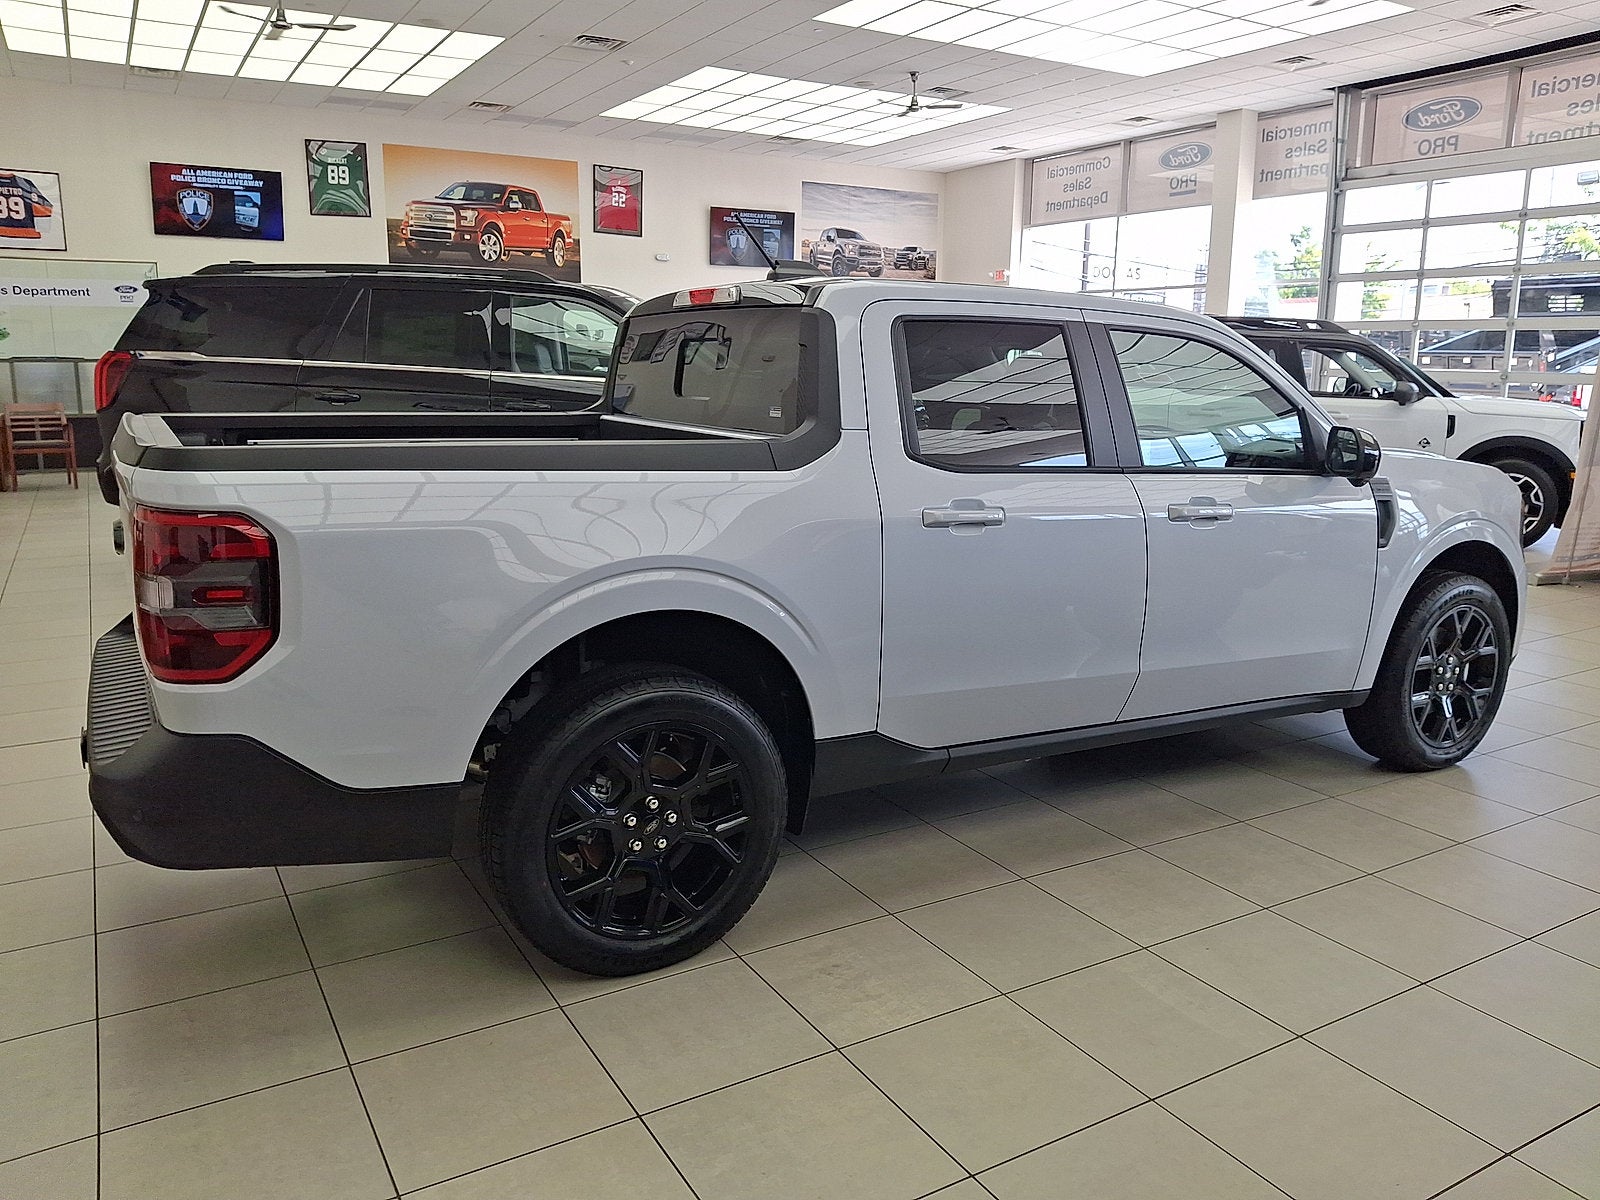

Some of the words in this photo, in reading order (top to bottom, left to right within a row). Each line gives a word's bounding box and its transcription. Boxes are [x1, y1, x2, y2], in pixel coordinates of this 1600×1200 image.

[170, 174, 196, 182] POLICE
[227, 179, 263, 187] GIVEAWAY
[196, 170, 233, 178] AMERICAN
[234, 172, 253, 180] FORD
[327, 165, 350, 185] 89
[180, 190, 210, 200] POLICE
[612, 192, 626, 208] 22
[12, 285, 91, 297] Department
